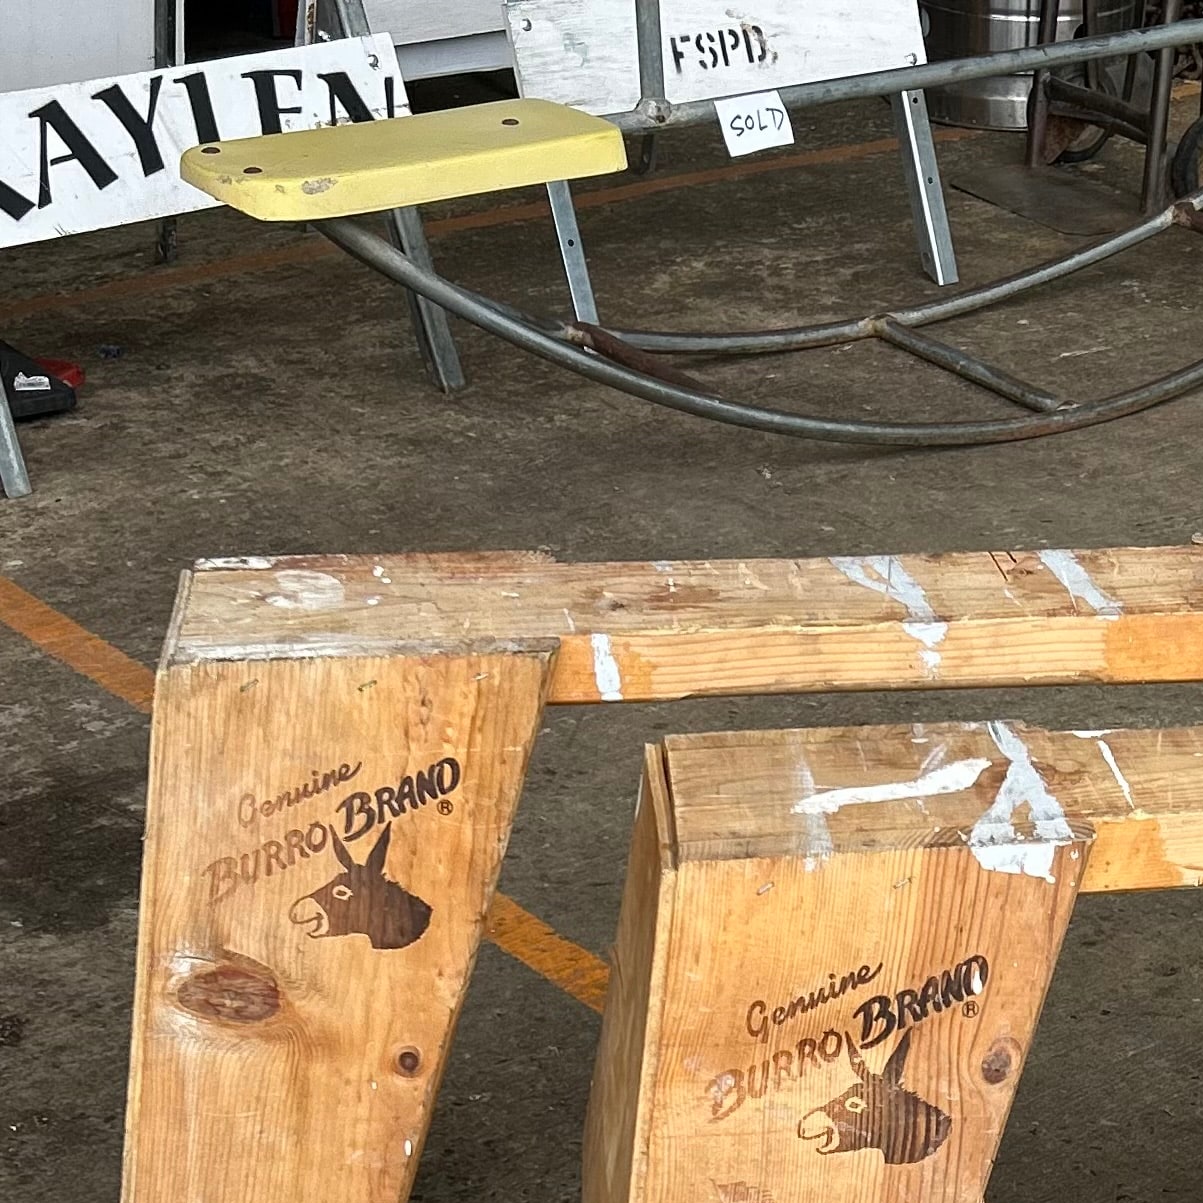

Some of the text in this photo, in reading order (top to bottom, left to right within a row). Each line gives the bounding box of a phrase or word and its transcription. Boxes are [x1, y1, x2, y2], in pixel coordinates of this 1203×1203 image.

[729, 107, 784, 137] SOLD
[237, 760, 363, 829] Genuine
[200, 820, 328, 907] BURRO
[746, 961, 884, 1044] Genuine
[704, 1027, 843, 1124] BURRO
